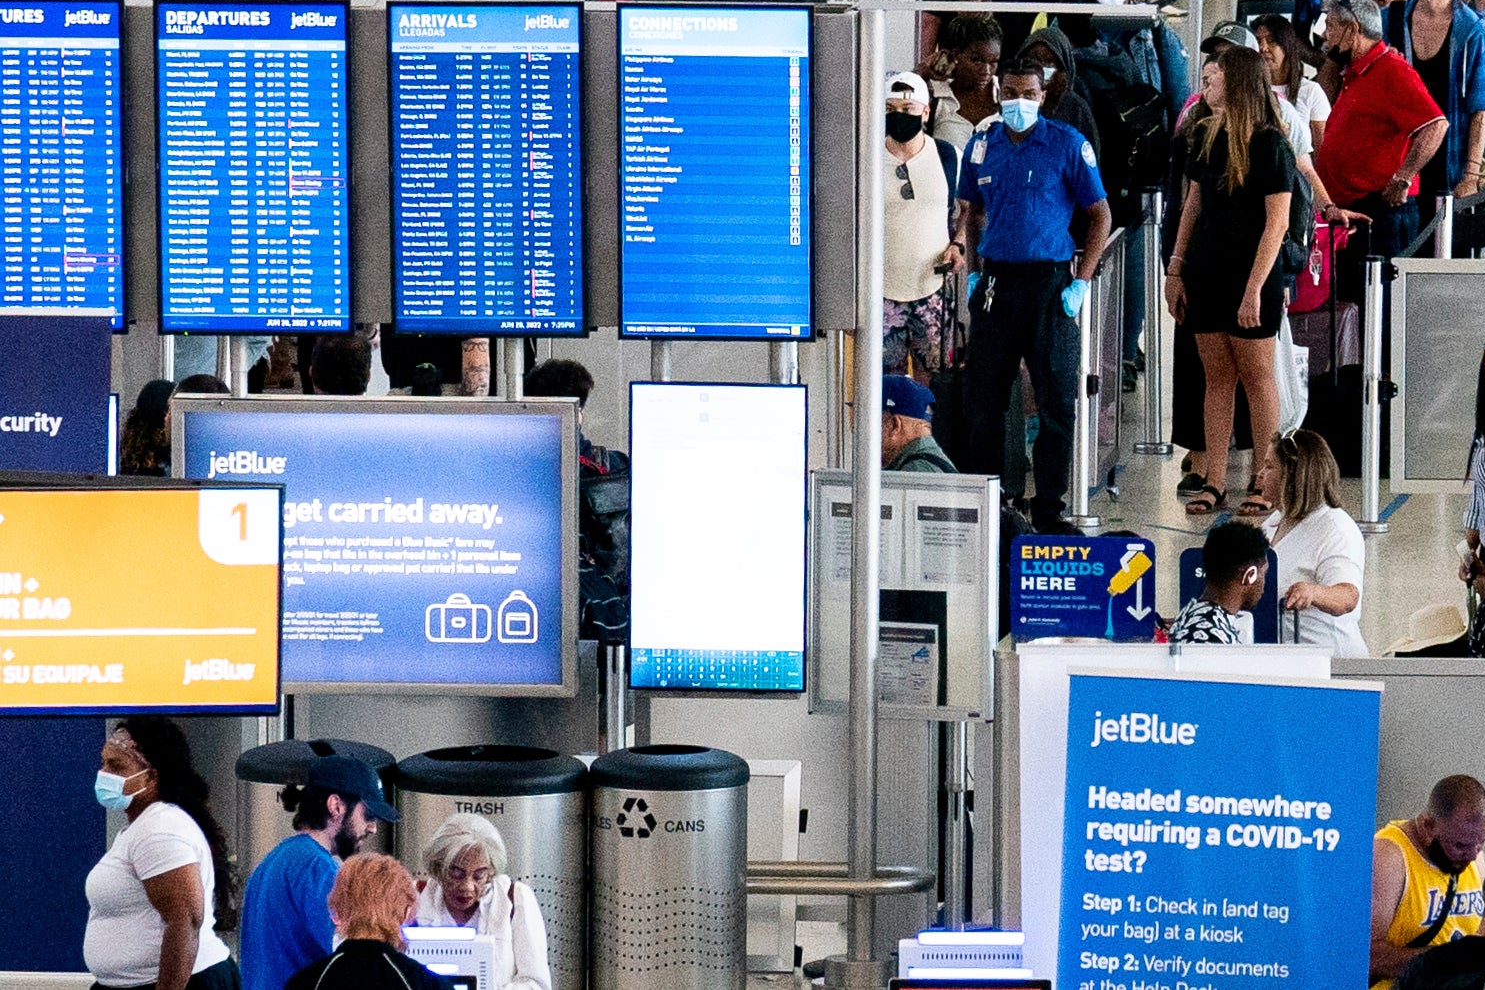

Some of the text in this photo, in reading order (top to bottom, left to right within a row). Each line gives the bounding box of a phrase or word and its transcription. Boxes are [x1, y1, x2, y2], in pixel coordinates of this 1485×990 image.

[0, 9, 111, 28] URES jetBlue
[165, 11, 338, 29] DEPARTURES jetBlue
[399, 14, 571, 32] ARRIVALS jetBlue
[628, 16, 738, 32] CONNECTIONS
[165, 24, 204, 35] SALIDAS
[399, 27, 446, 37] LLEGADAS
[208, 451, 287, 478] jetBlue
[230, 502, 249, 542] 1
[284, 497, 503, 530] get carried away.
[402, 536, 424, 548] Blue
[1021, 545, 1091, 560] EMPTY
[1021, 561, 1105, 576] LIQUIDS
[1020, 576, 1077, 591] HERE
[22, 597, 72, 620] BAG
[3, 664, 124, 684] SU EQUIPAJE
[182, 658, 256, 686] jetBlue
[1091, 712, 1199, 748] jetBlue
[455, 801, 505, 815] TRASH
[1088, 785, 1332, 821] Headed somewhere
[664, 820, 705, 833] CANS
[1086, 821, 1340, 852] requiring a COVID-19
[1084, 850, 1148, 874] test?
[1082, 893, 1290, 924] Step 1: Check in (and tag
[1421, 888, 1485, 927] LAERS
[1081, 922, 1244, 944] your bag) at a kiosk
[1080, 952, 1290, 978] Step 2: Verify documents
